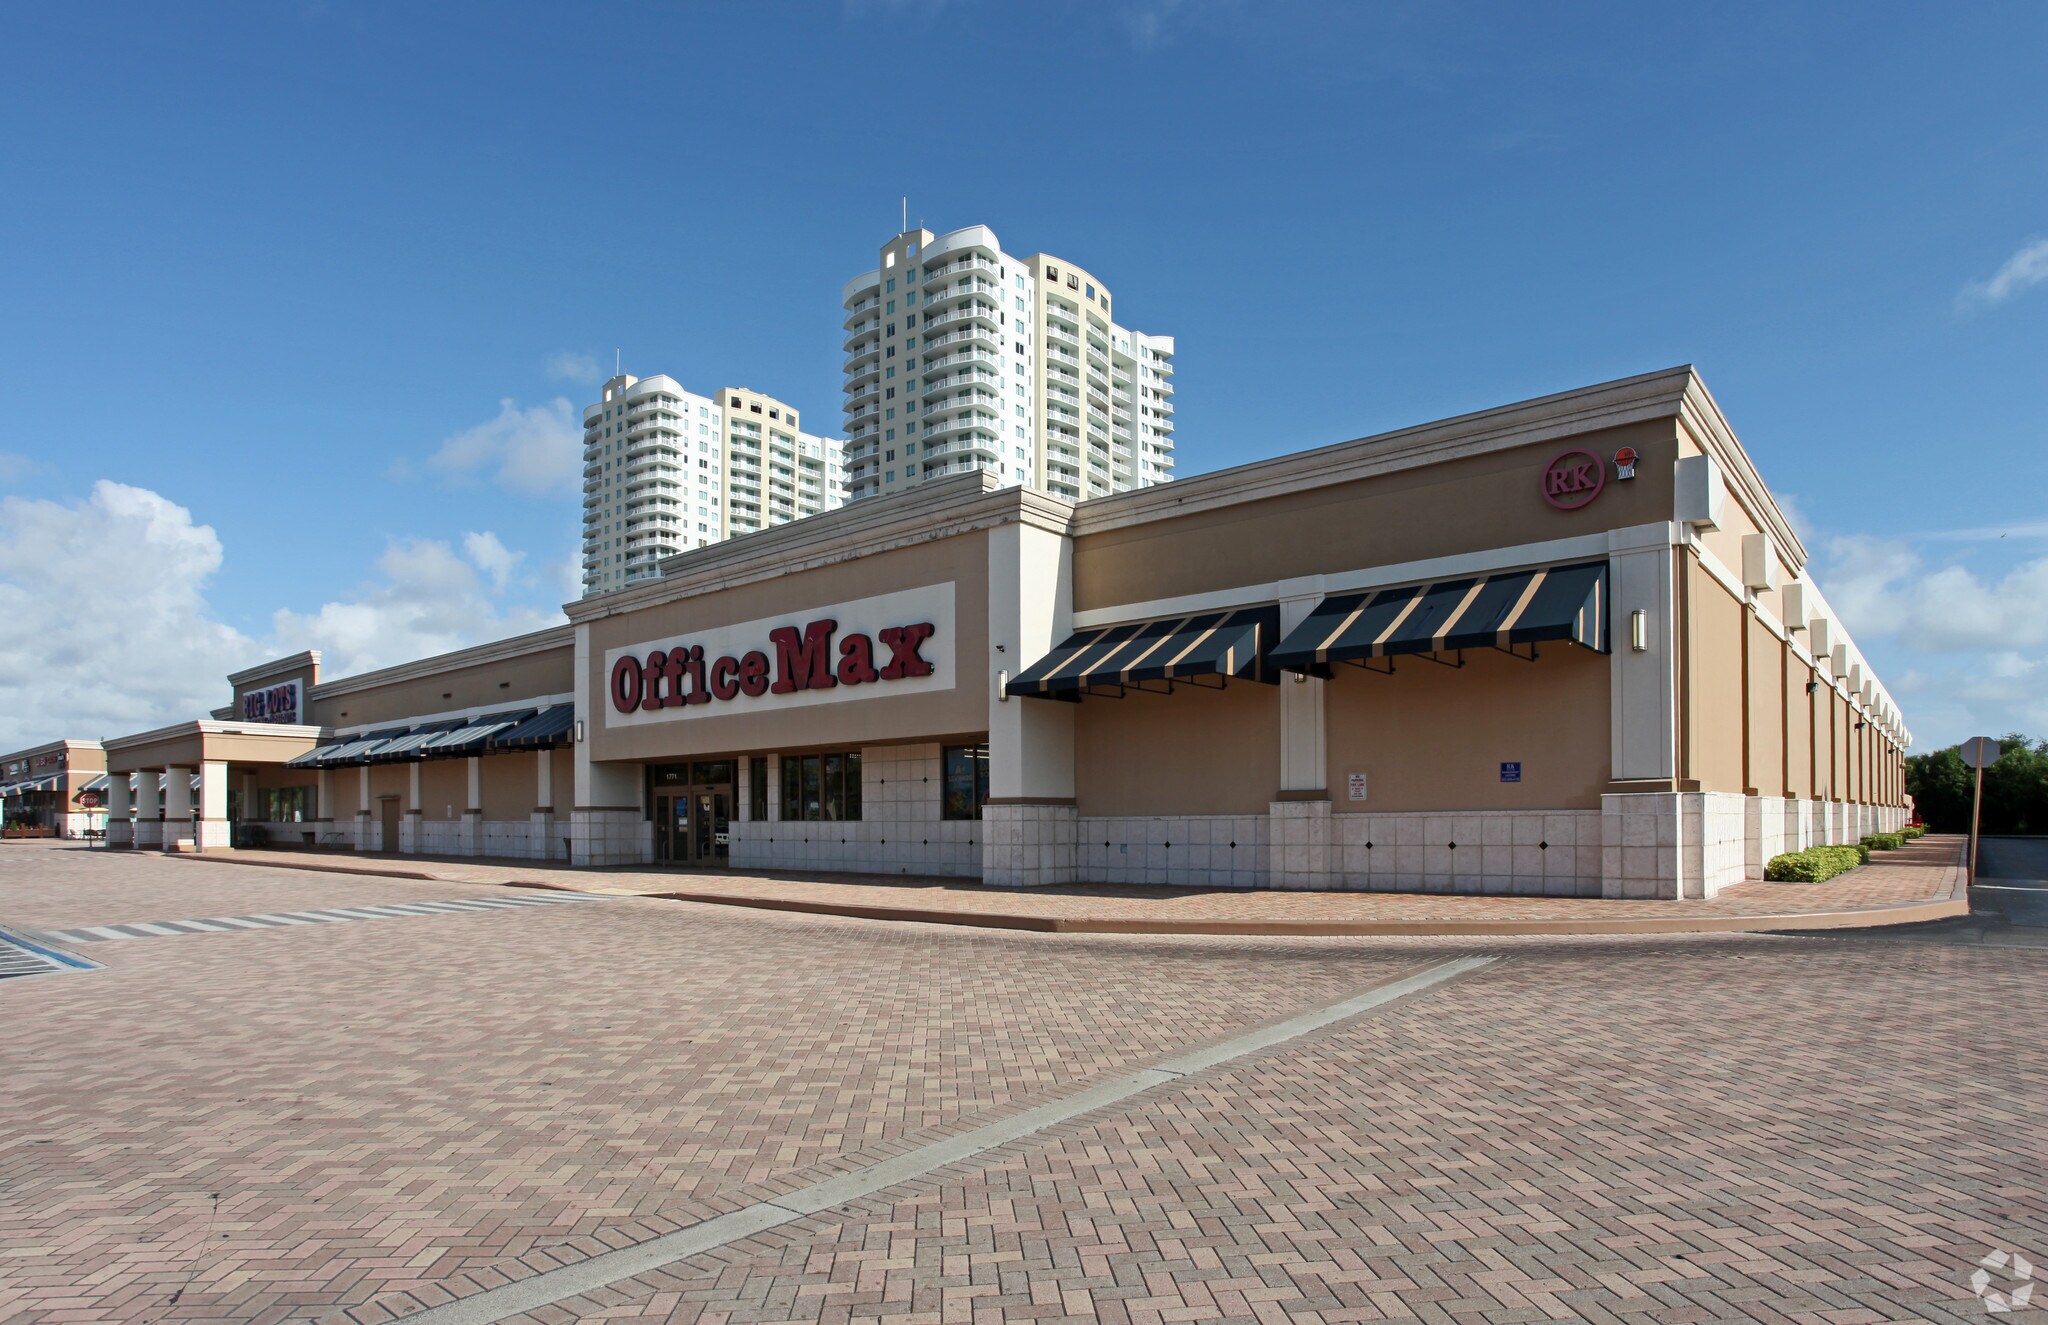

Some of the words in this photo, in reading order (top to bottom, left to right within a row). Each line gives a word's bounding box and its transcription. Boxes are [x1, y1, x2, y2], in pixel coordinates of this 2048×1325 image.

[1549, 463, 1596, 495] RK
[611, 618, 935, 713] OfficeMax
[243, 692, 265, 720] BIG
[265, 684, 296, 713] LOTS
[81, 797, 98, 805] STOP
